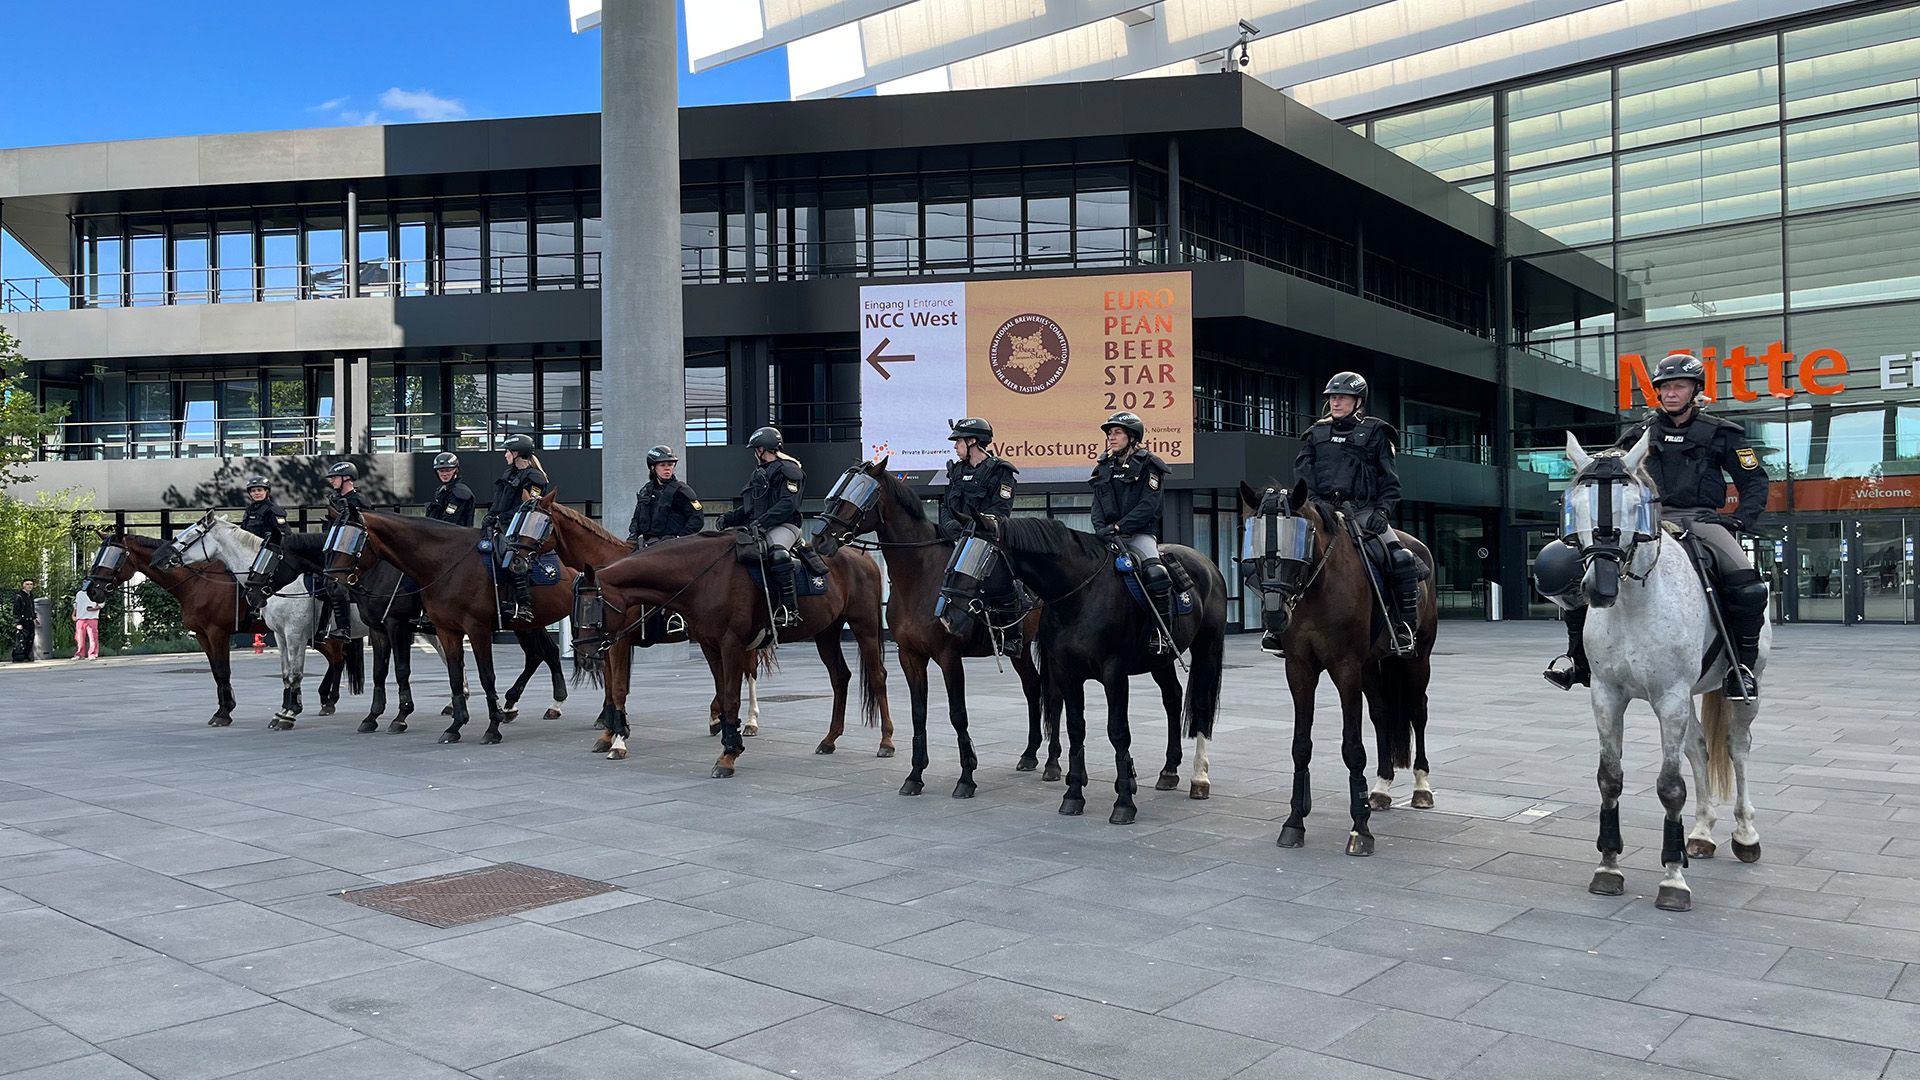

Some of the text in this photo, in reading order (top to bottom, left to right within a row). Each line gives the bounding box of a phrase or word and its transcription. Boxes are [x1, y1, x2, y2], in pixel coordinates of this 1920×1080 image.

[864, 299, 954, 311] Eingang Entrance
[1103, 287, 1175, 311] EURO
[865, 311, 958, 329] NCC West
[1104, 314, 1173, 335] PEAN
[991, 321, 1015, 367] INTERNATIONAL
[1049, 324, 1068, 365] COMPETITION
[1104, 338, 1175, 361] BEER
[995, 366, 1064, 393] THE BEER TASTING AWARD
[1104, 363, 1176, 386] STAR
[1618, 340, 1848, 410] Mitte
[1104, 390, 1175, 410] 2023
[993, 441, 1098, 459] Verkostung
[1855, 489, 1911, 499] Welcome
